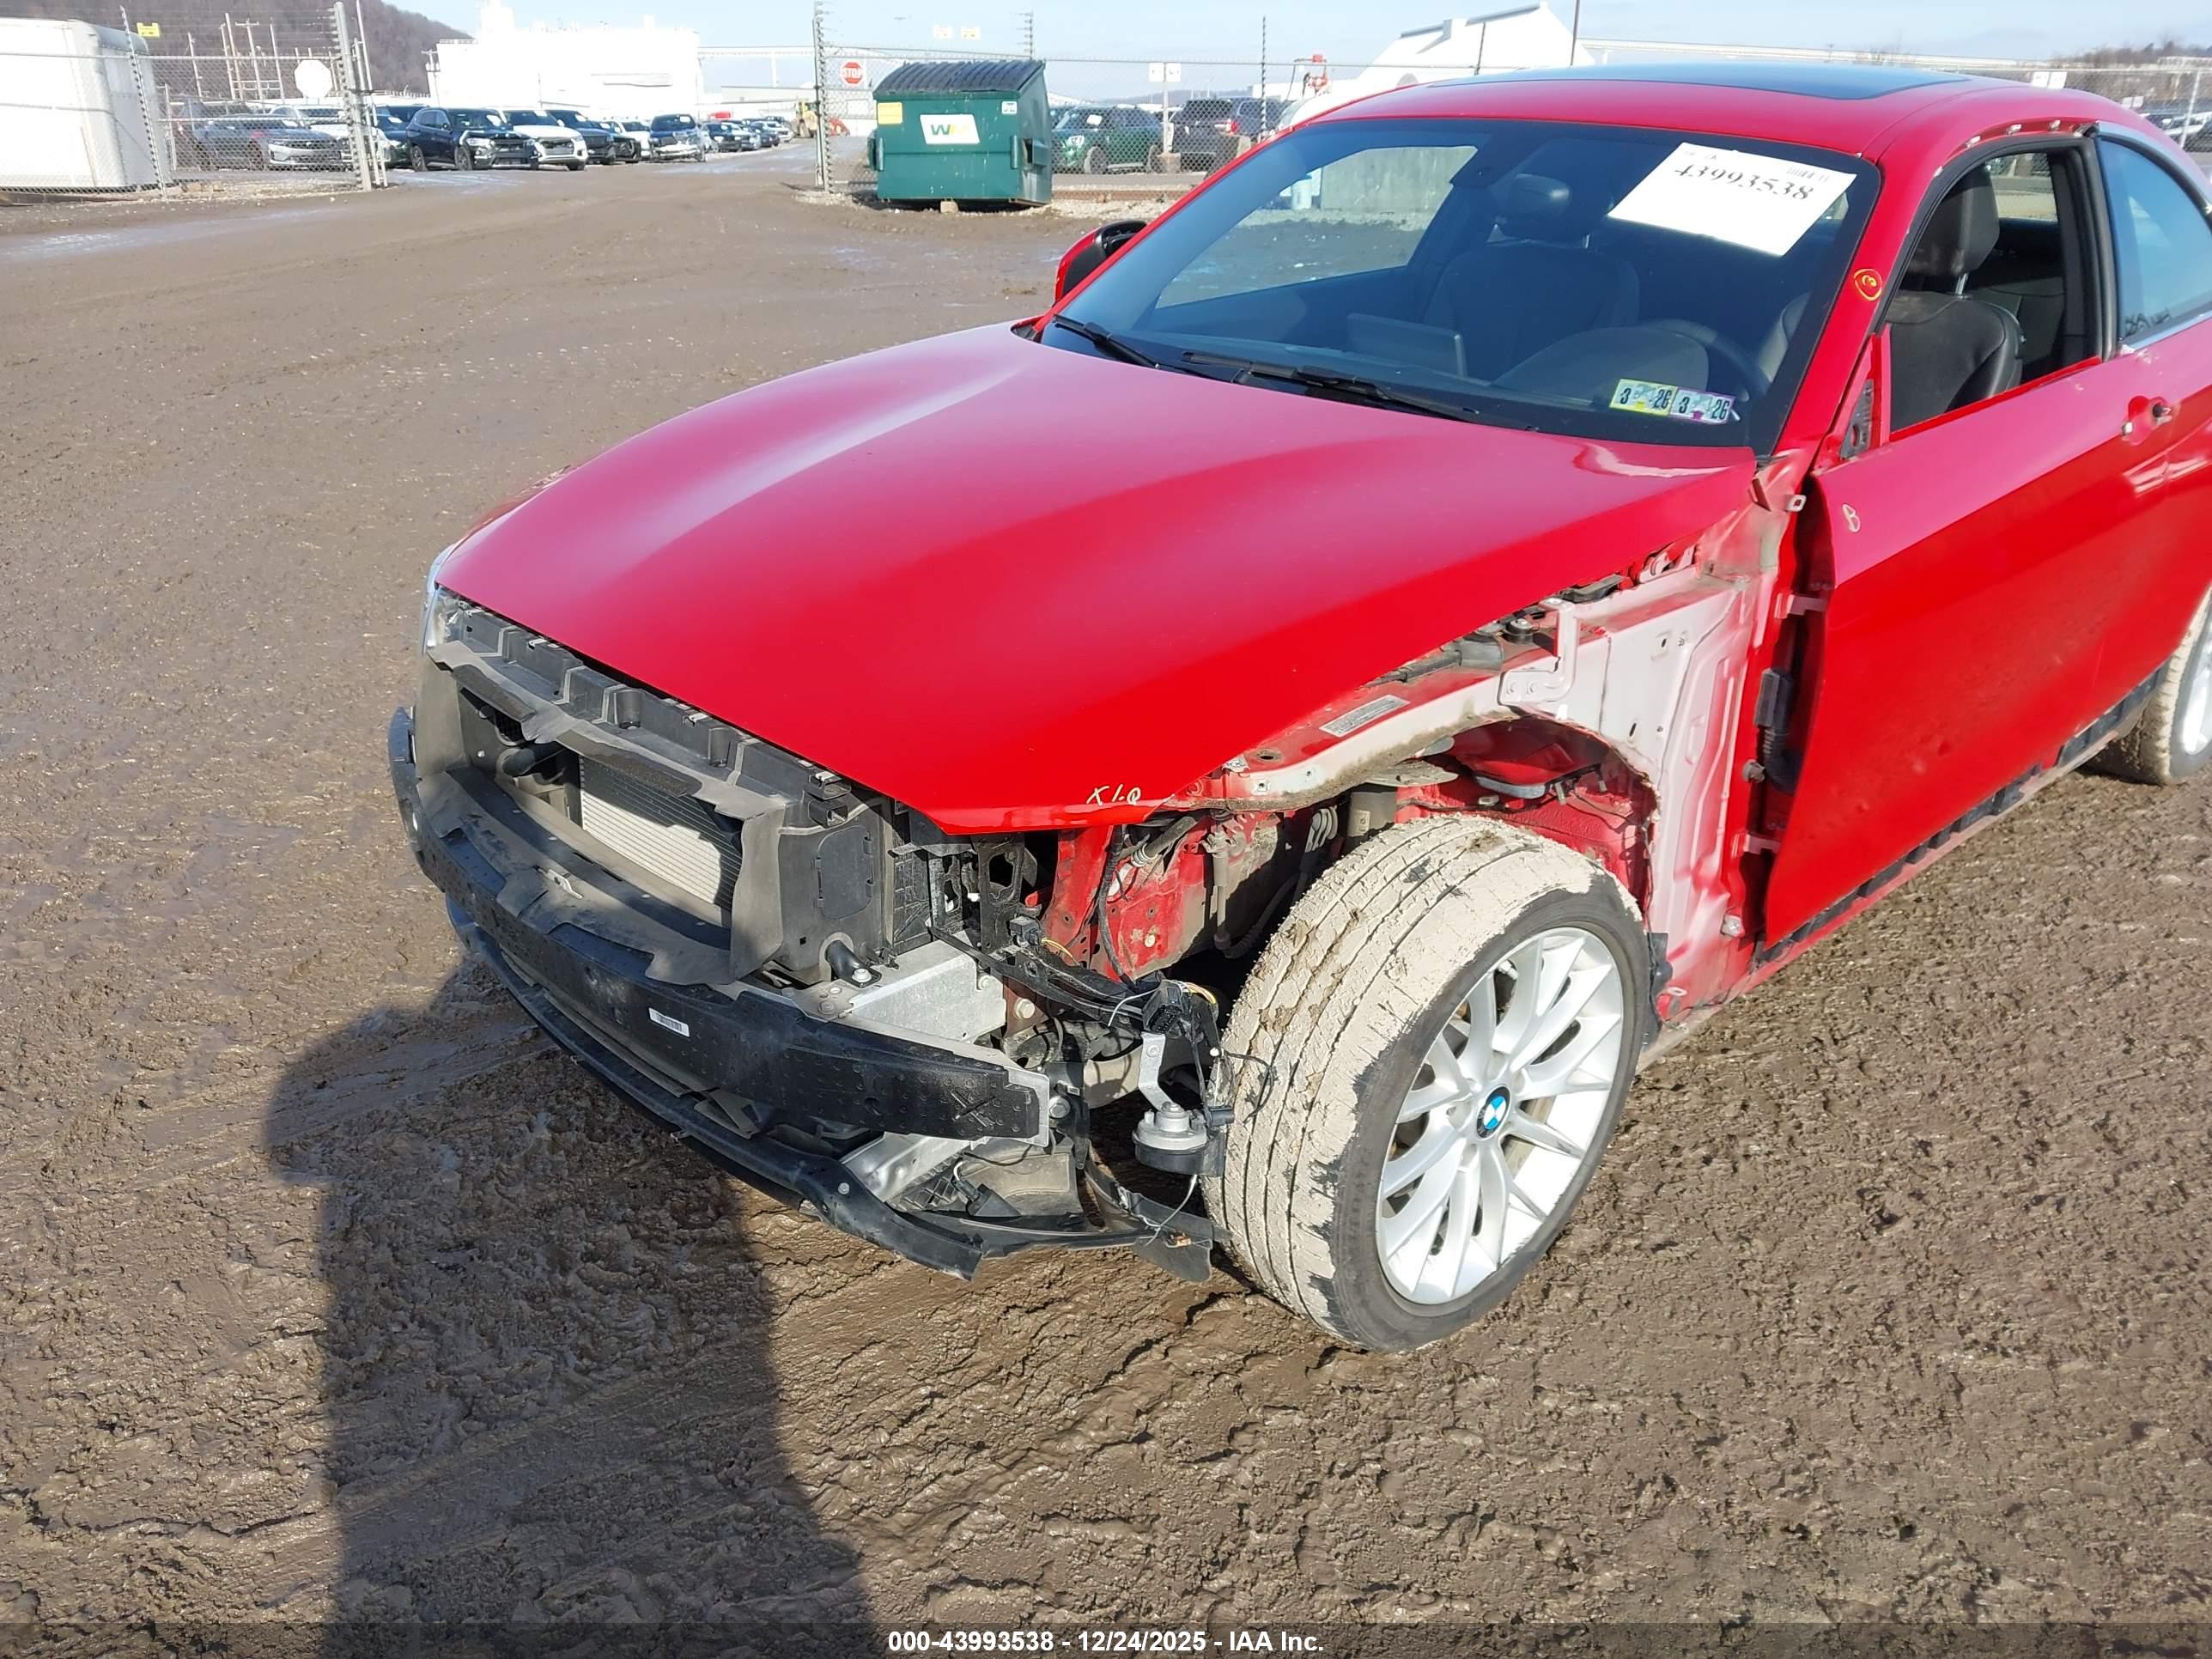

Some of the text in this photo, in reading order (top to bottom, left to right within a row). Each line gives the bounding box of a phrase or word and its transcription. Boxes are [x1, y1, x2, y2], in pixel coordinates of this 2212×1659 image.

[842, 68, 863, 78] STOP
[1674, 163, 1814, 200] 43993538
[1620, 387, 1673, 410] 3 26
[1678, 396, 1730, 420] 3 26
